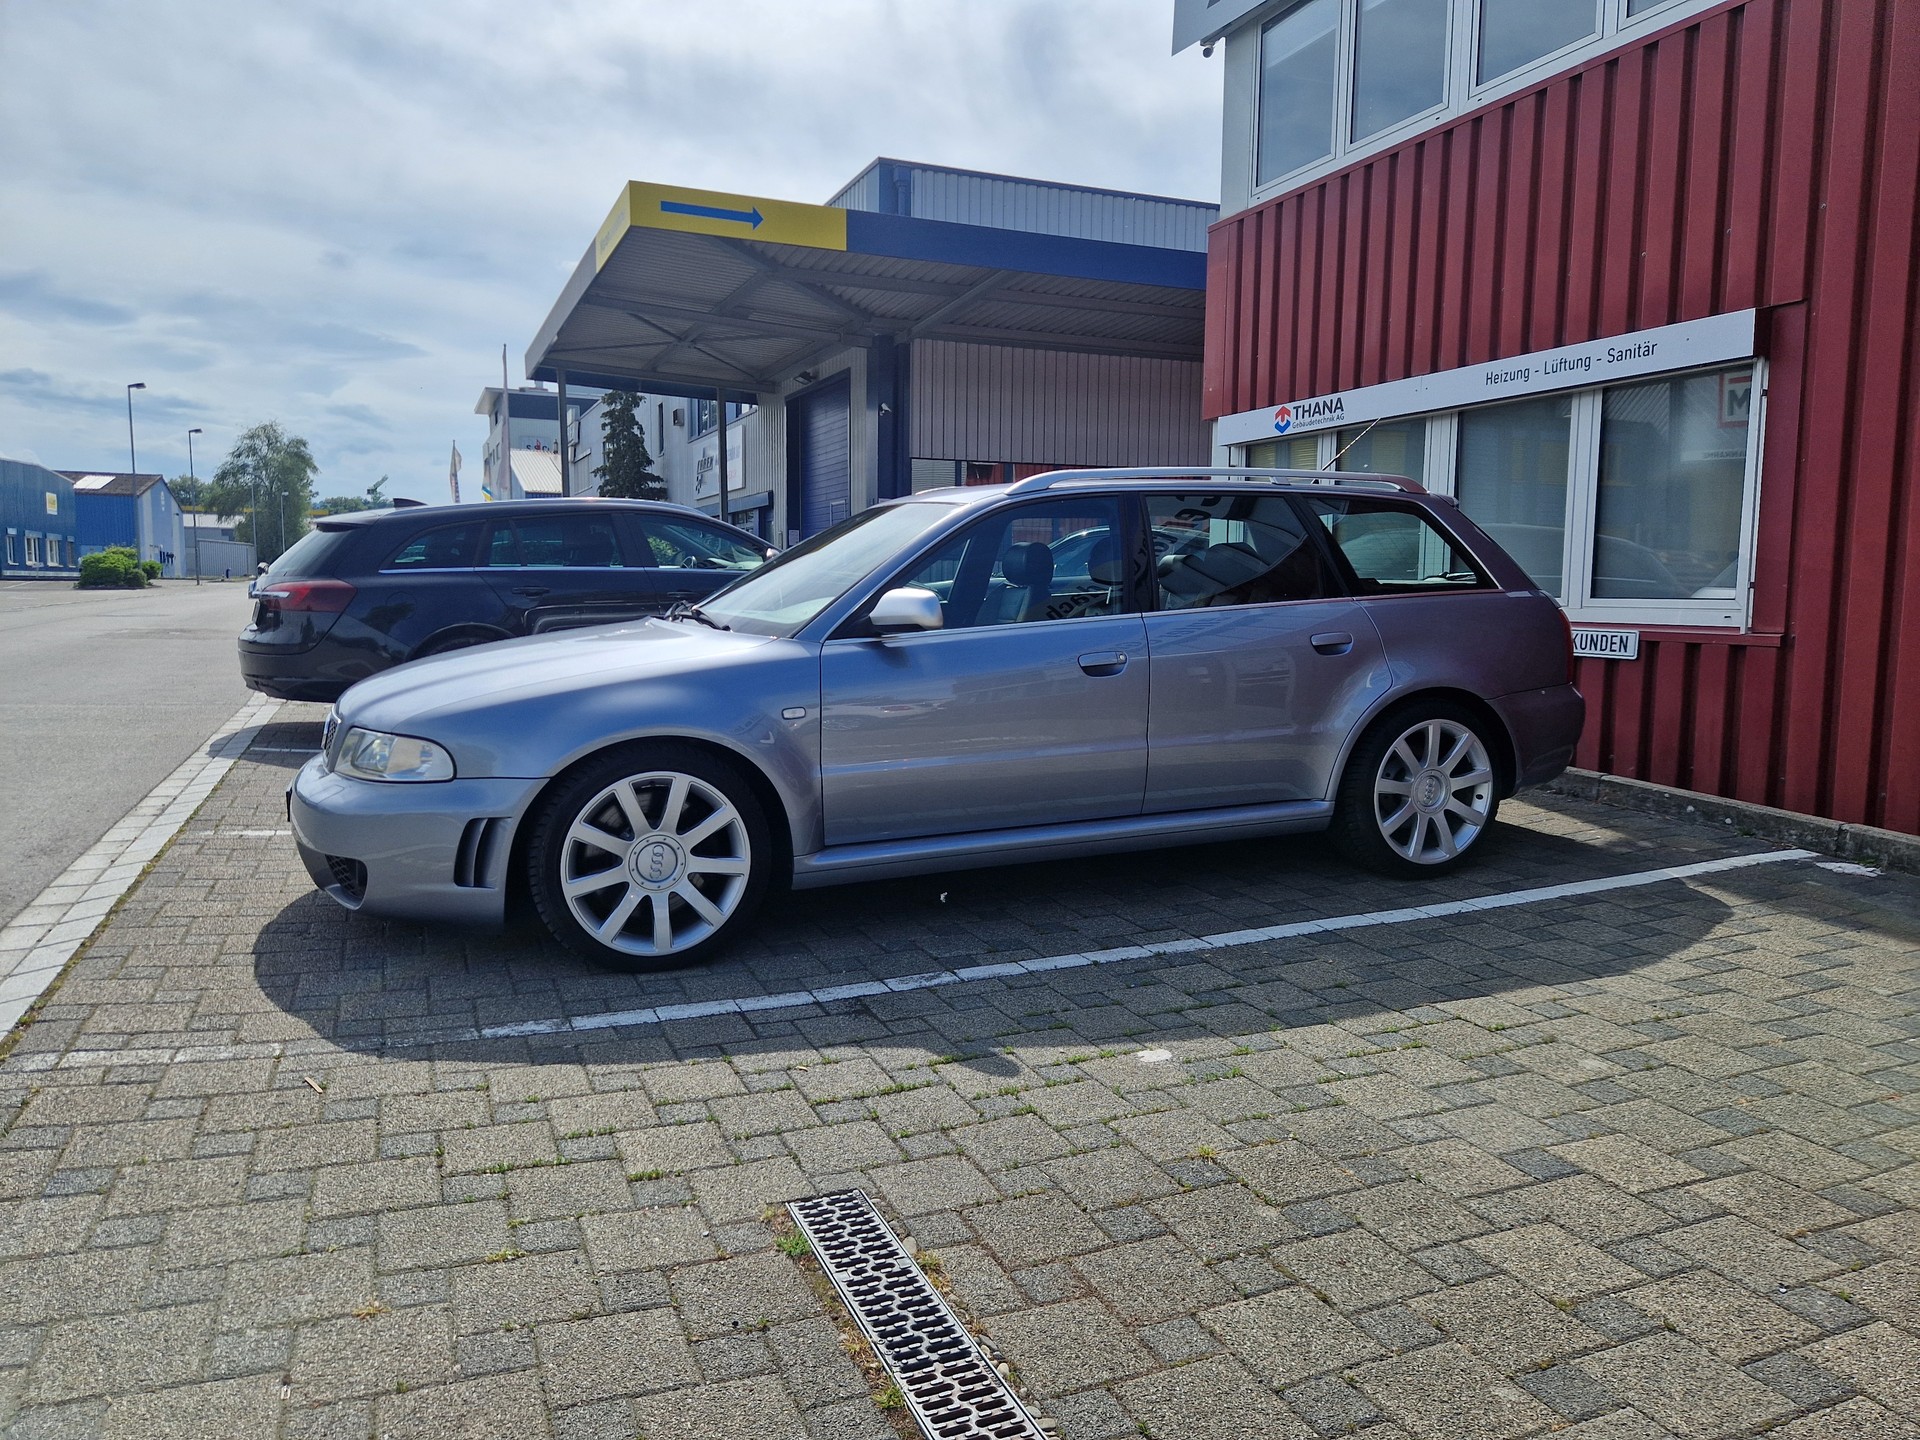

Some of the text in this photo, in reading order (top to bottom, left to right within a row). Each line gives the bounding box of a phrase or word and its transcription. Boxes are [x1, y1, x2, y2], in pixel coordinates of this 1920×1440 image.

[1485, 367, 1530, 386] Heizung
[1544, 355, 1591, 376] Lüftung
[1607, 340, 1658, 363] Sanitär
[1293, 397, 1345, 420] THANA
[1292, 412, 1345, 429] Gebäudetechnik AG
[1573, 633, 1629, 653] KUNDEN
